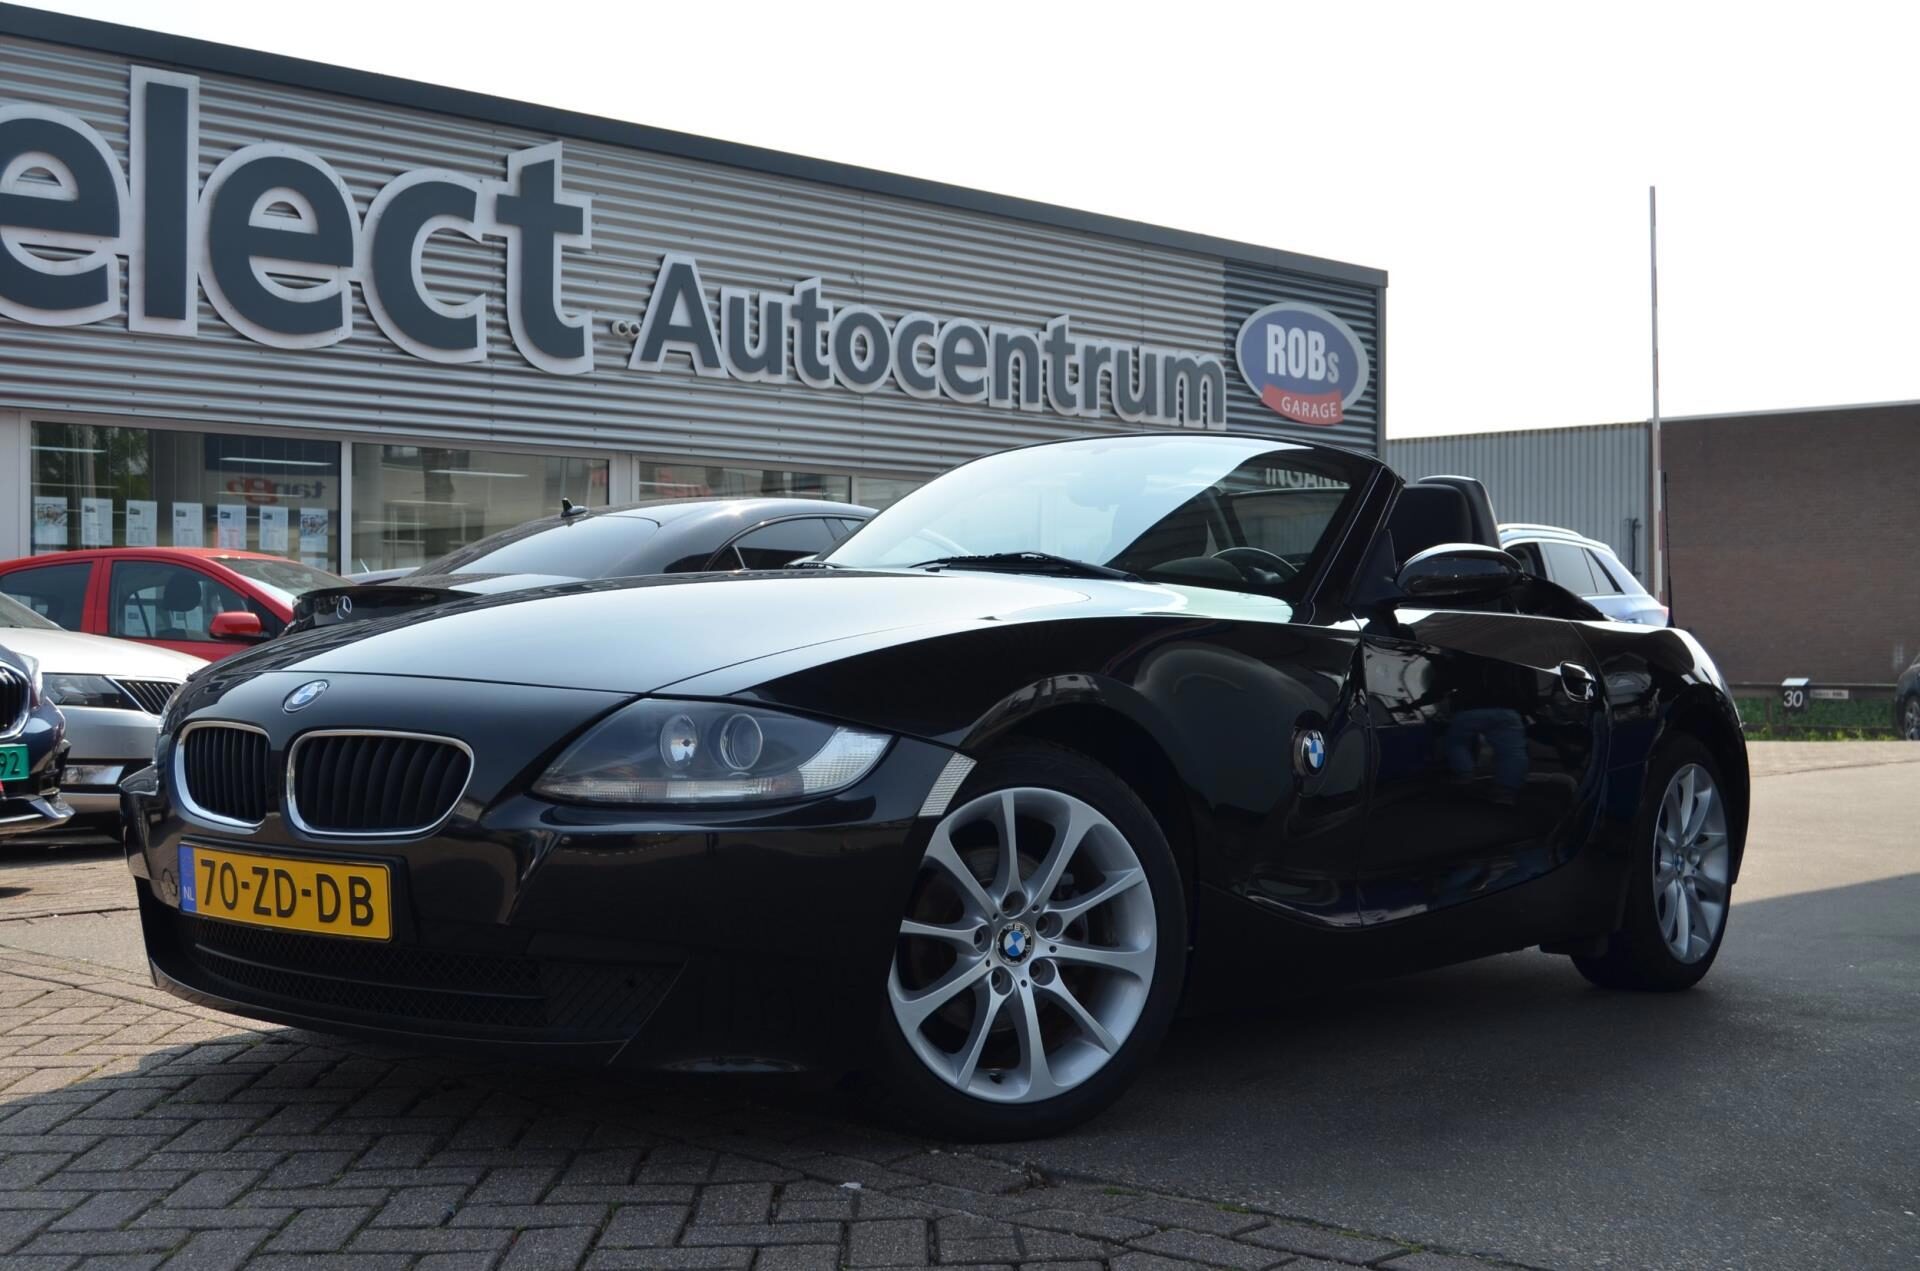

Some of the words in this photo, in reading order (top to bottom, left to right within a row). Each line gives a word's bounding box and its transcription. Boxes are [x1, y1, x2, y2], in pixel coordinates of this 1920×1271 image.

[0, 70, 590, 370] elect
[632, 257, 1226, 430] Autocentrum
[1266, 323, 1340, 384] ROBs
[1281, 396, 1338, 419] GARAGE
[1783, 690, 1804, 708] 30
[183, 886, 195, 902] NL
[200, 858, 375, 927] 70-ZD-DB
